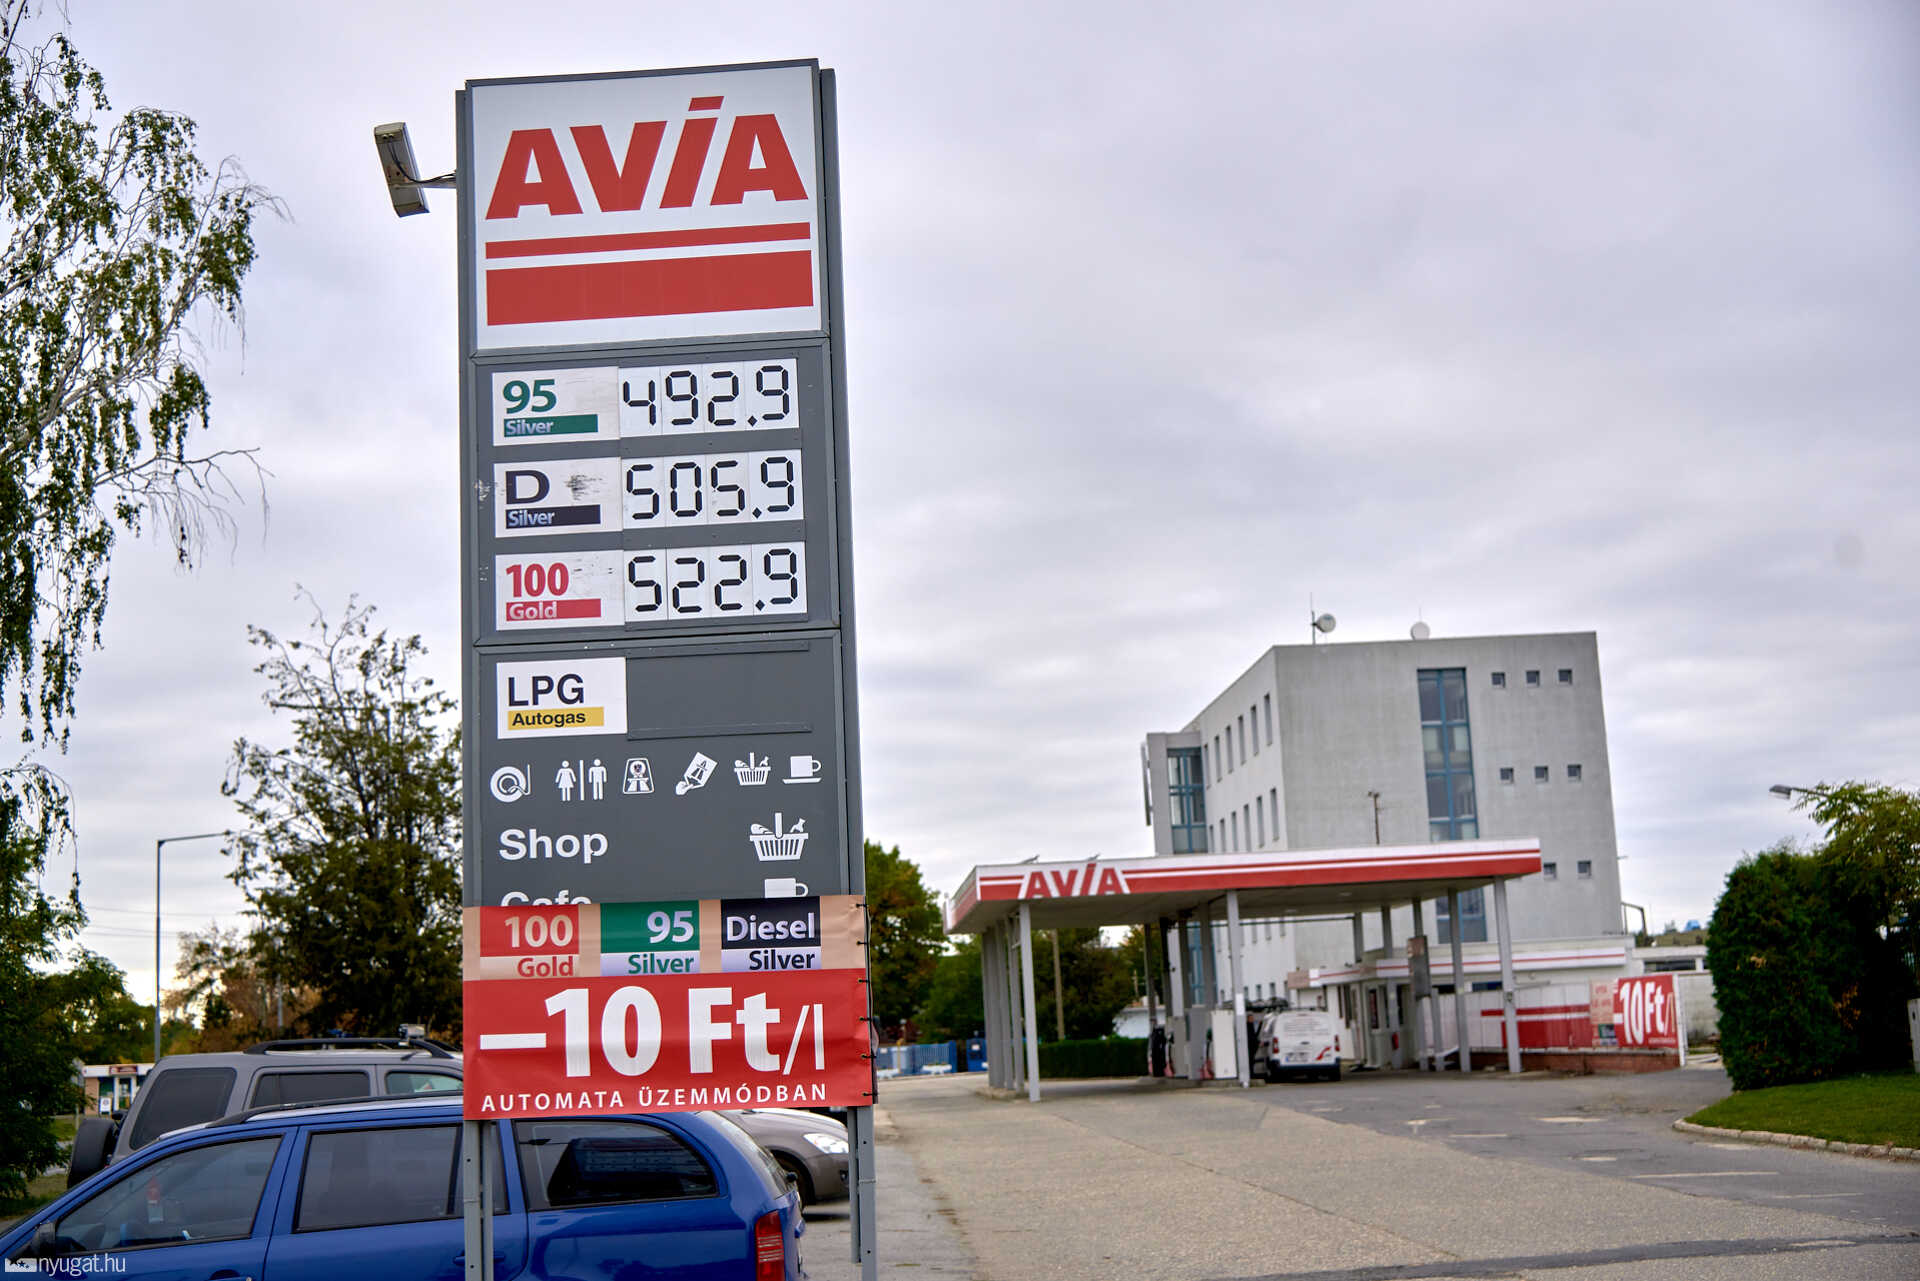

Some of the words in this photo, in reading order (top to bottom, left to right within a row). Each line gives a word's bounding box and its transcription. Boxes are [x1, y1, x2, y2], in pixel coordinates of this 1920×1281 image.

[502, 379, 557, 414] 95
[622, 365, 790, 427] 492.9
[505, 419, 554, 436] Silver
[505, 469, 550, 505] D
[626, 456, 795, 520] 505.9
[508, 510, 555, 528] Silver
[505, 562, 569, 598] 100
[628, 548, 798, 613] 522.9
[509, 601, 558, 621] Gold
[508, 673, 584, 707] LPG
[512, 710, 586, 728] Autogas
[499, 828, 608, 864] Shop
[504, 915, 574, 948] 100
[646, 910, 695, 944] 95
[726, 912, 815, 942] Diesel
[517, 955, 574, 978] Gold
[628, 953, 695, 975] Silver
[748, 949, 815, 971] Silver
[688, 987, 825, 1075] Ft/l
[481, 1089, 624, 1112] AUTOMATA
[639, 1083, 827, 1107] ÜZEMMÓDBAN
